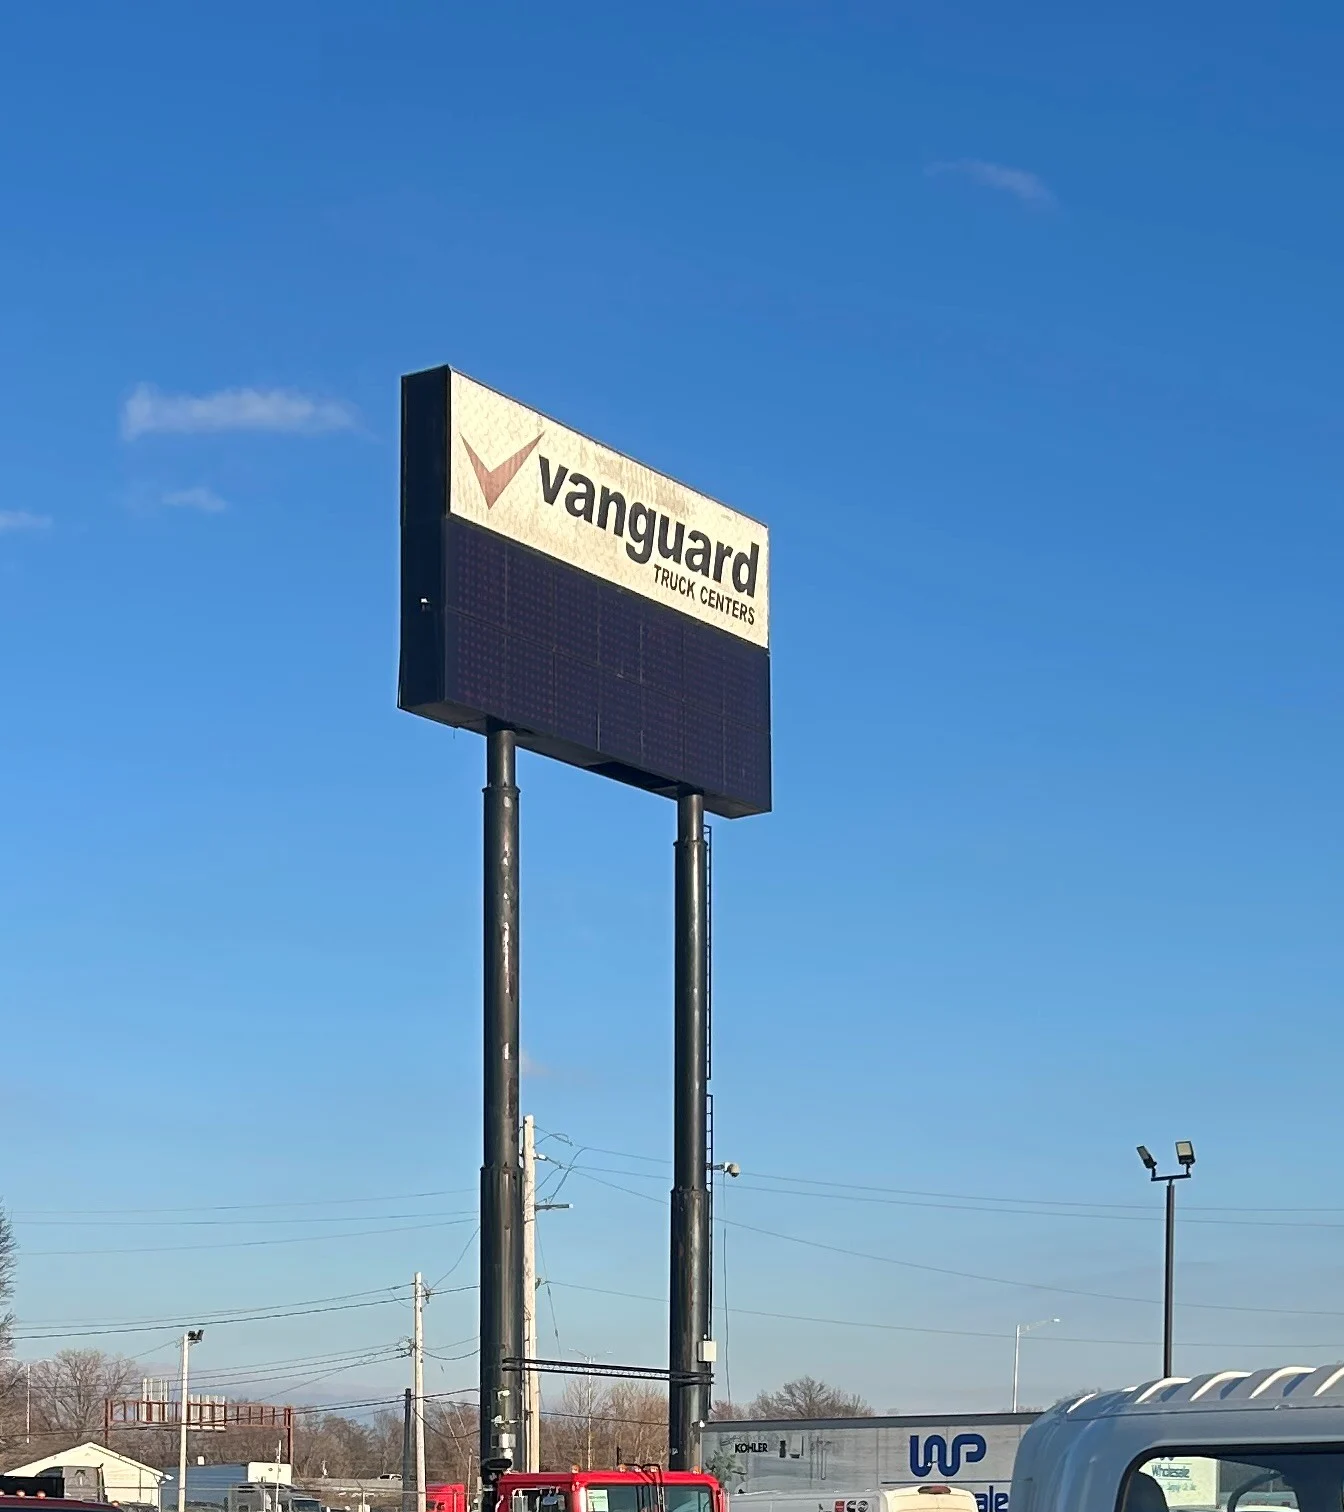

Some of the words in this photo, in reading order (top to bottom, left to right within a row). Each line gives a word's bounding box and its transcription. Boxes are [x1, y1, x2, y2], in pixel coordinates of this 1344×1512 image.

[538, 454, 760, 599] vanguard
[653, 564, 697, 600] TRUCK
[699, 585, 756, 626] CENTERS
[734, 1442, 768, 1453] KOHLER
